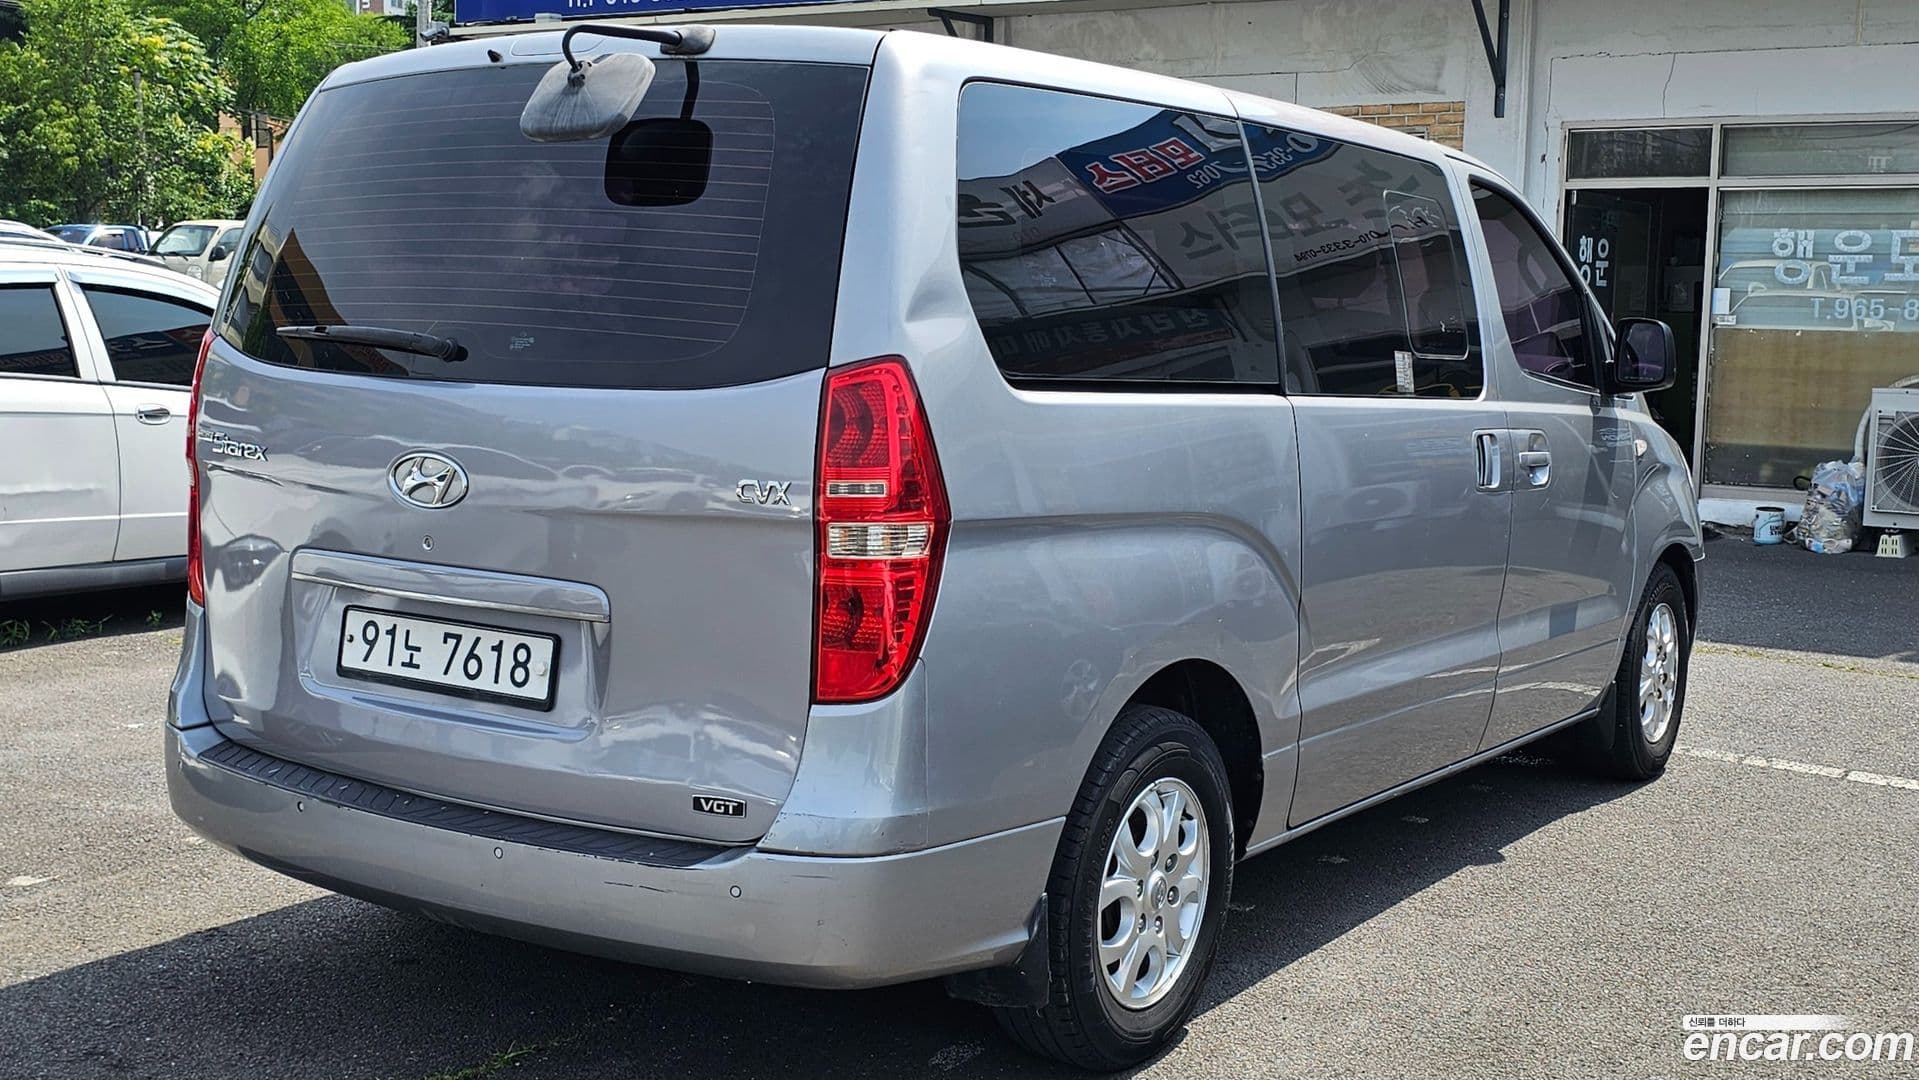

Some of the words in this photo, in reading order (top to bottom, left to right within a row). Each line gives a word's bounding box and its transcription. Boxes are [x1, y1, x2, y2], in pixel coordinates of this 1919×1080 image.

[212, 431, 267, 461] Starex
[736, 479, 792, 506] CVX
[361, 619, 422, 670] 91노
[442, 631, 532, 689] 7618
[700, 798, 738, 815] VGT
